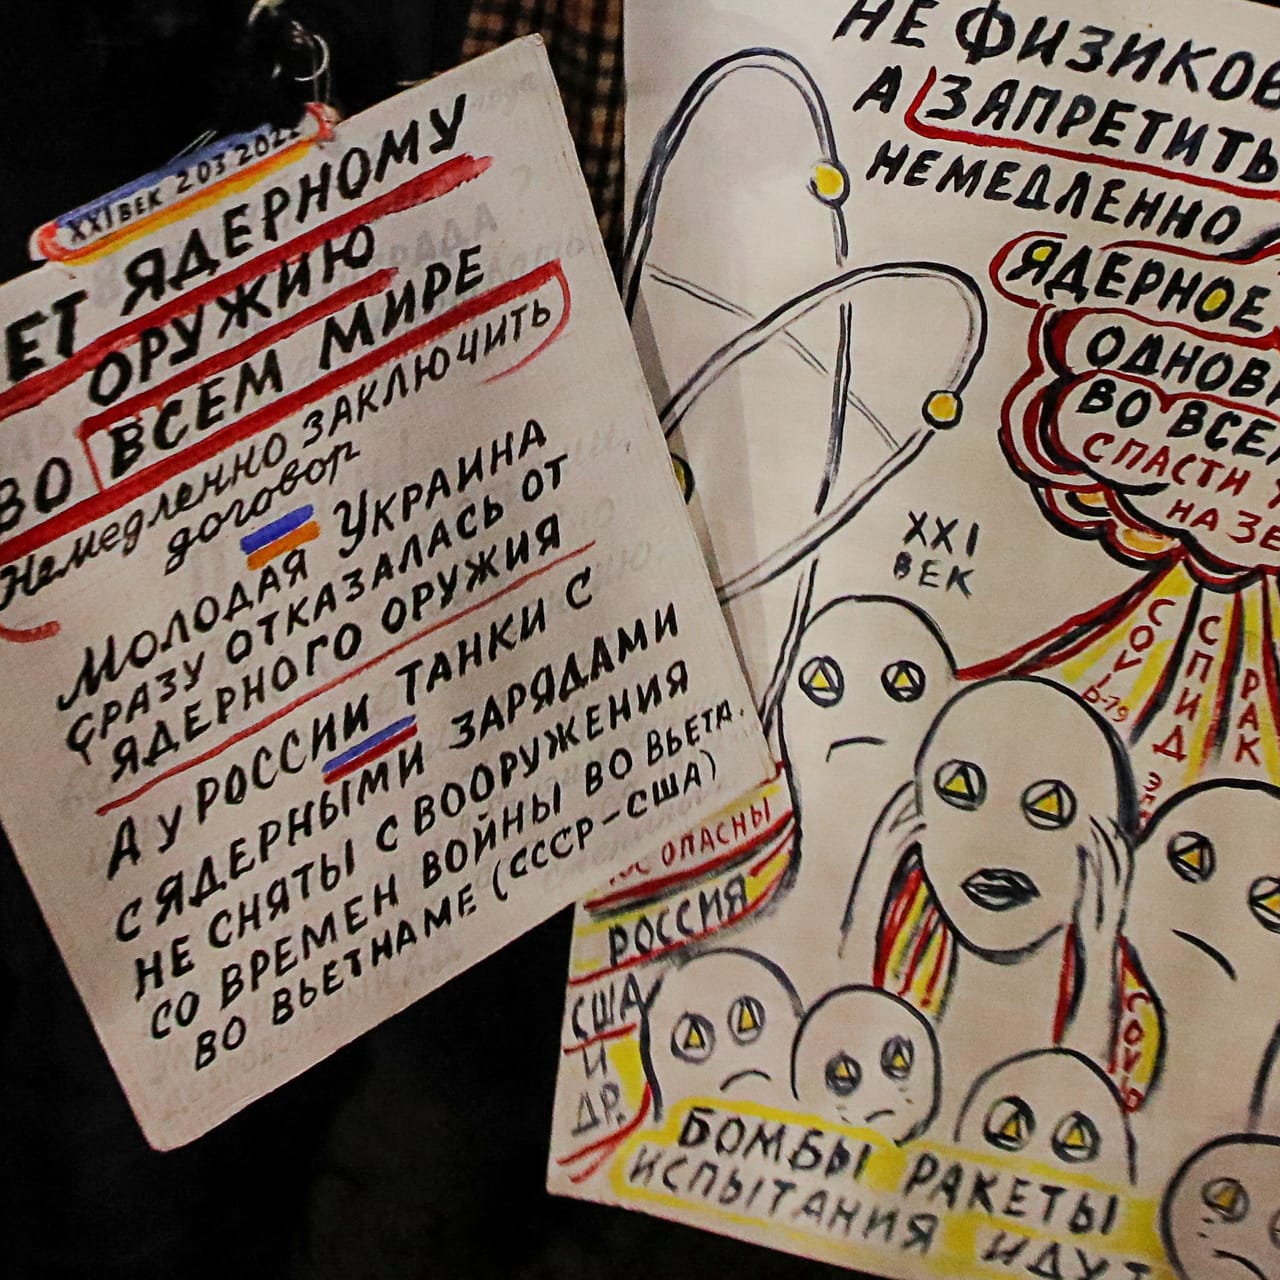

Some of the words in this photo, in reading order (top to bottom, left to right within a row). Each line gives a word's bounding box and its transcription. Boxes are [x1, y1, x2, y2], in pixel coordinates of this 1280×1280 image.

[853, 65, 902, 113] А
[925, 75, 1278, 183] ЗАПРЕТИТЬ
[120, 94, 466, 316] ЯДЕРНОМУ
[866, 140, 1241, 241] НЕМЕДЛЕННО
[89, 224, 374, 406] ОРУЖИЮ
[1006, 240, 1271, 332] ЯДЕРНОЕ
[108, 349, 283, 479] ВСЕМ
[319, 245, 484, 370] МИРЕ
[303, 299, 550, 447] ЗАКЛЮЧИТЬ
[1076, 379, 1151, 428] ВО
[1084, 432, 1251, 496] СПАСТИ
[1167, 498, 1219, 532] НА
[59, 549, 307, 711] МОЛОДАЯ
[333, 420, 546, 558] УКРАИНА
[66, 652, 204, 762] СРАЗУ
[226, 495, 503, 664] ОТКАЗАЛАСЬ
[522, 454, 567, 502] ОТ
[894, 551, 974, 599] ВЕК
[111, 623, 361, 783] ЯДЕРНОГО
[382, 514, 560, 634] ОРУЖИЯ
[107, 816, 141, 880] А
[197, 694, 368, 824] РОССИИ
[395, 598, 545, 706] ТАНКИ
[566, 567, 592, 609] С
[115, 897, 142, 942] С
[156, 741, 424, 926] ЯДЕРНЫМИ
[449, 603, 677, 749] ЗАРЯДАМИ
[1233, 669, 1261, 765] РАК
[135, 935, 194, 1001] НЕ
[209, 839, 354, 948] СНЯТЫ
[376, 815, 398, 852] С
[414, 660, 687, 836] ВООРУЖЕНИЯ
[661, 797, 771, 867] ОПАСНЫ
[152, 991, 199, 1039] СО
[221, 874, 398, 1010] ВРЕМЕН
[423, 782, 560, 888] ВОЙНЫ
[586, 748, 632, 797] ВО
[608, 873, 748, 966] РОССИЯ
[195, 1016, 246, 1071] ВО
[273, 883, 476, 1025] ВЬЕТНАМЕ
[571, 973, 640, 1040] США
[584, 1046, 606, 1077] И
[629, 1146, 939, 1254] ИСПЫТАНИЯ
[678, 1107, 870, 1178] БОМБЫ
[905, 1154, 1118, 1234] РАКЕТЫ
